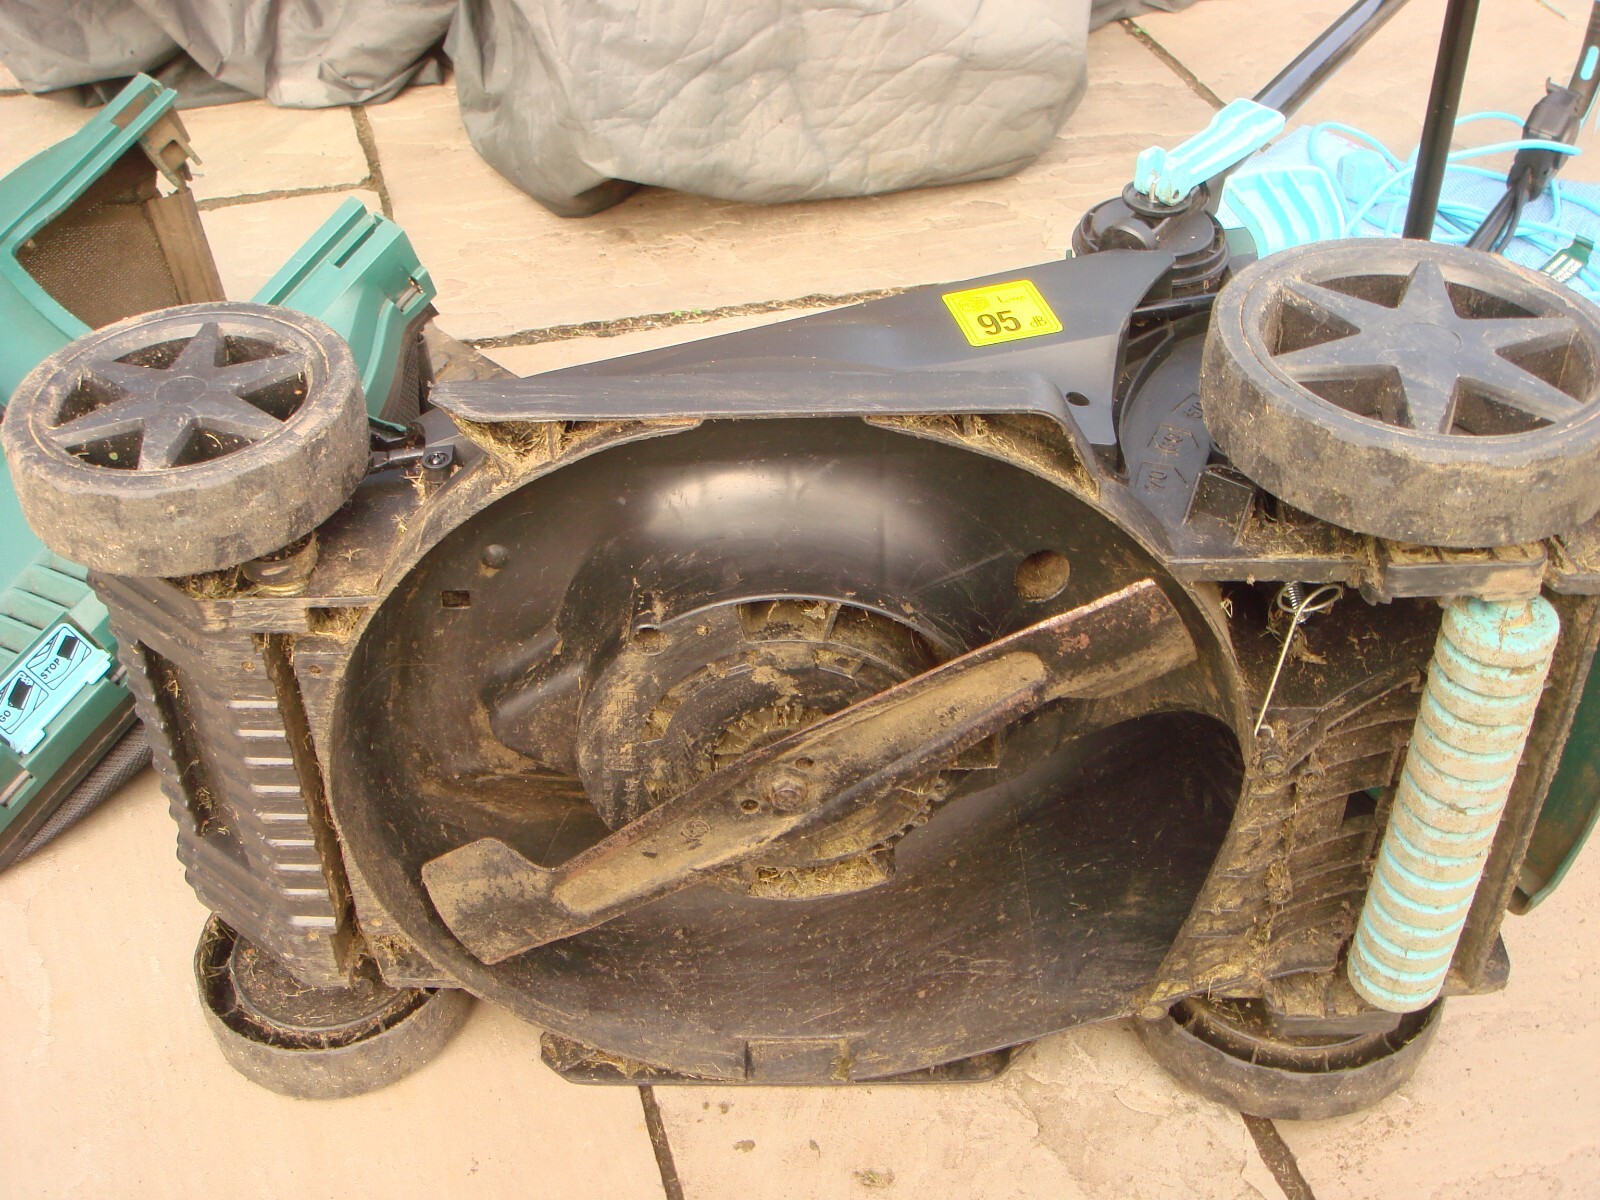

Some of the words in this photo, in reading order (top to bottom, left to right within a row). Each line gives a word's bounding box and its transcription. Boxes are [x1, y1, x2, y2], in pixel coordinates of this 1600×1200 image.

[977, 310, 1022, 336] 95
[1030, 315, 1047, 328] dB
[40, 657, 61, 680] STOP
[0, 710, 11, 723] GO
